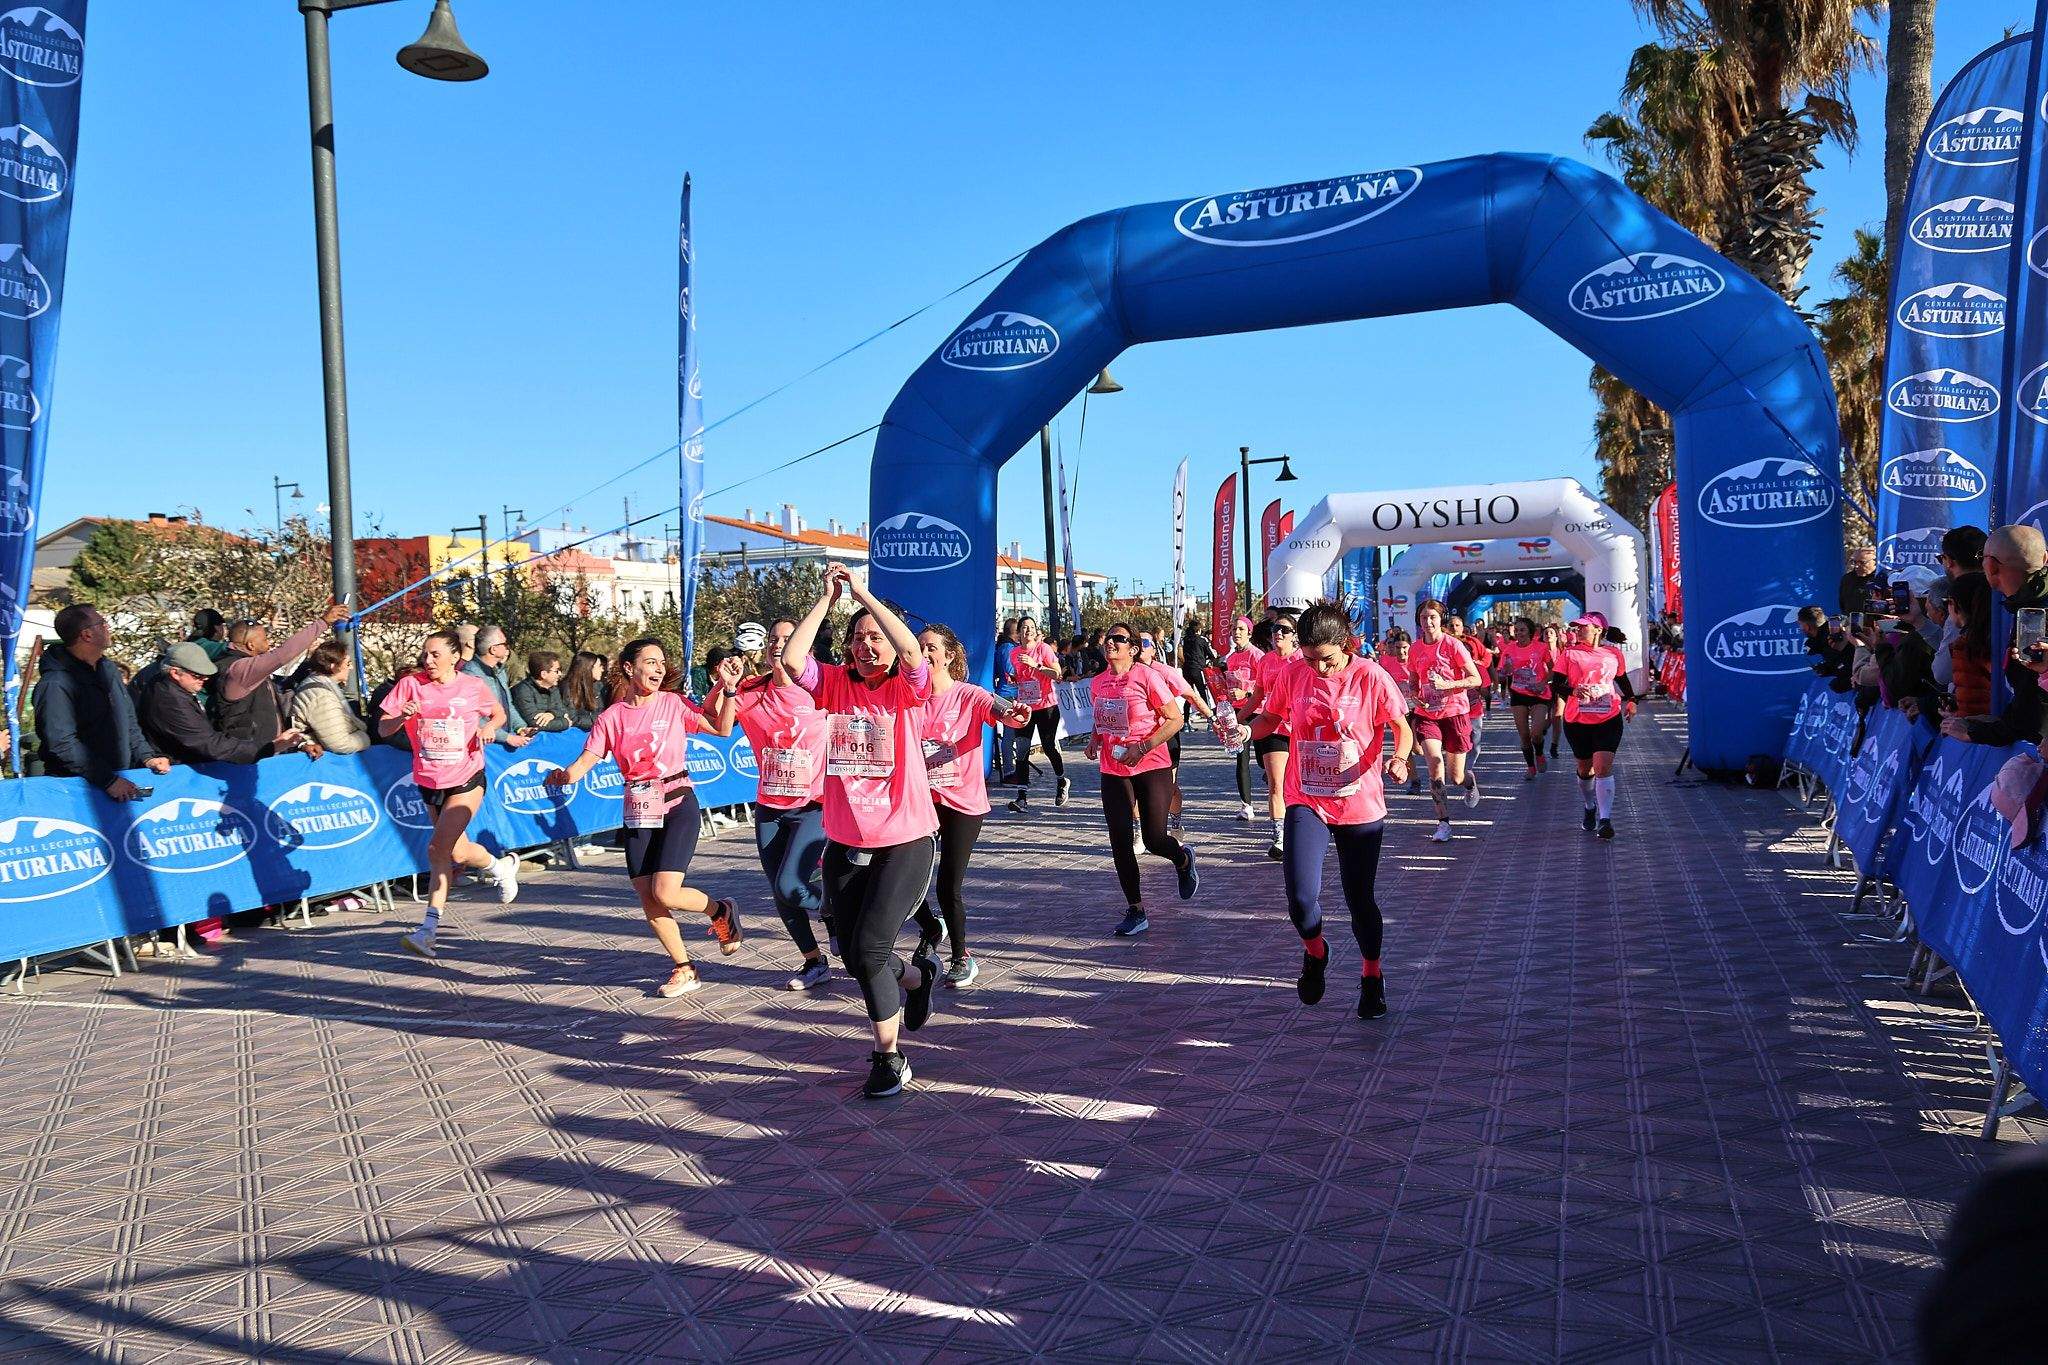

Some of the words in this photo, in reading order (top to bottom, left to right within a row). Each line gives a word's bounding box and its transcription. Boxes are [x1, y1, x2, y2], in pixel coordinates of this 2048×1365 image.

[1190, 176, 1403, 231] ASTURIANA
[1602, 274, 1652, 289] CENTRAL
[1657, 268, 1707, 279] LECHERA
[1581, 277, 1716, 311] ASTURIANA
[1904, 302, 2005, 326] ASTURIANA
[1004, 328, 1046, 337] LECHERA
[946, 337, 1050, 360] ASTURIANA
[1894, 386, 1991, 412] ASTURIANA
[1727, 481, 1778, 492] CENTRAL
[1886, 466, 1977, 494] ASTURIANA
[1706, 488, 1830, 515] ASTURIANA
[1372, 494, 1520, 532] OYSHO
[882, 532, 916, 540] CENTRAL
[919, 532, 960, 540] LECHERA
[1564, 520, 1613, 534] OYSHO
[873, 536, 964, 559] ASTURIANA
[1219, 499, 1231, 577] Santander
[1288, 539, 1332, 550] OYSHO
[1486, 576, 1560, 587] VOLVO
[1734, 628, 1783, 638] CENTRAL
[850, 743, 875, 753] 016
[777, 770, 796, 779] 016
[1318, 766, 1341, 776] 016
[631, 802, 649, 810] 016
[152, 823, 198, 836] CENTRAL
[277, 807, 374, 839] ASTURIANA
[138, 825, 252, 861] ASTURIANA
